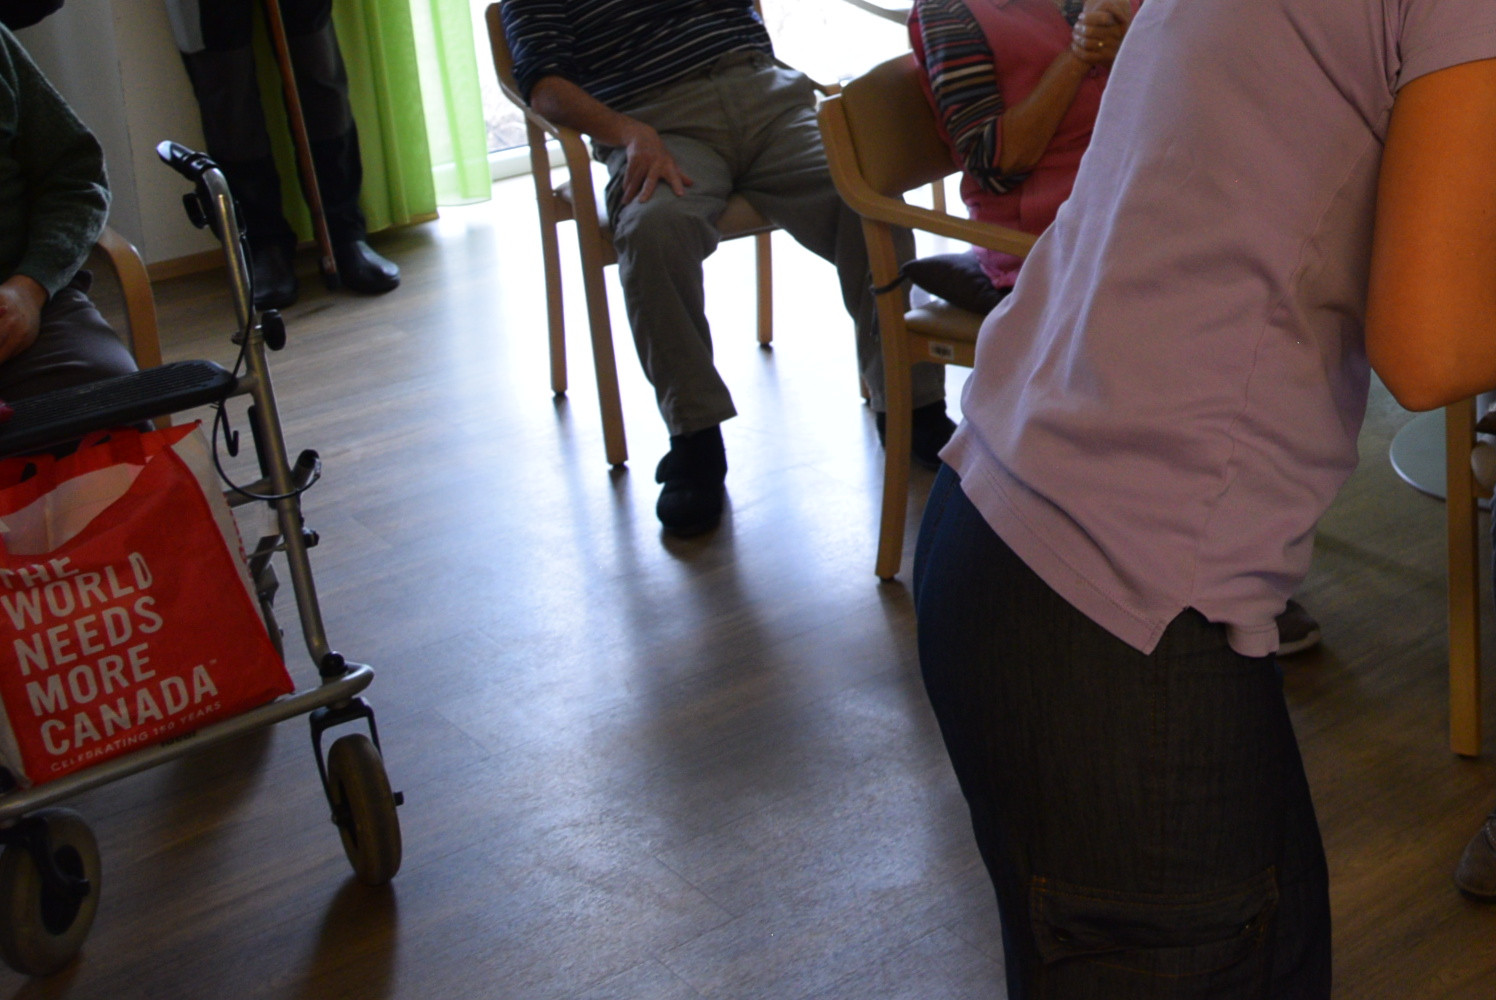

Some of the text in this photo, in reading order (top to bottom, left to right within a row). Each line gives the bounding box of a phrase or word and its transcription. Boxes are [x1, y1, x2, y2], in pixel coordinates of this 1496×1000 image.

[0, 556, 80, 589] THE
[0, 551, 153, 631] WORLD
[13, 595, 163, 676] NEEDS
[25, 642, 156, 717] MORE
[40, 664, 219, 756] CANADA
[50, 731, 149, 772] CELEBRATING
[180, 701, 222, 725] YEARS
